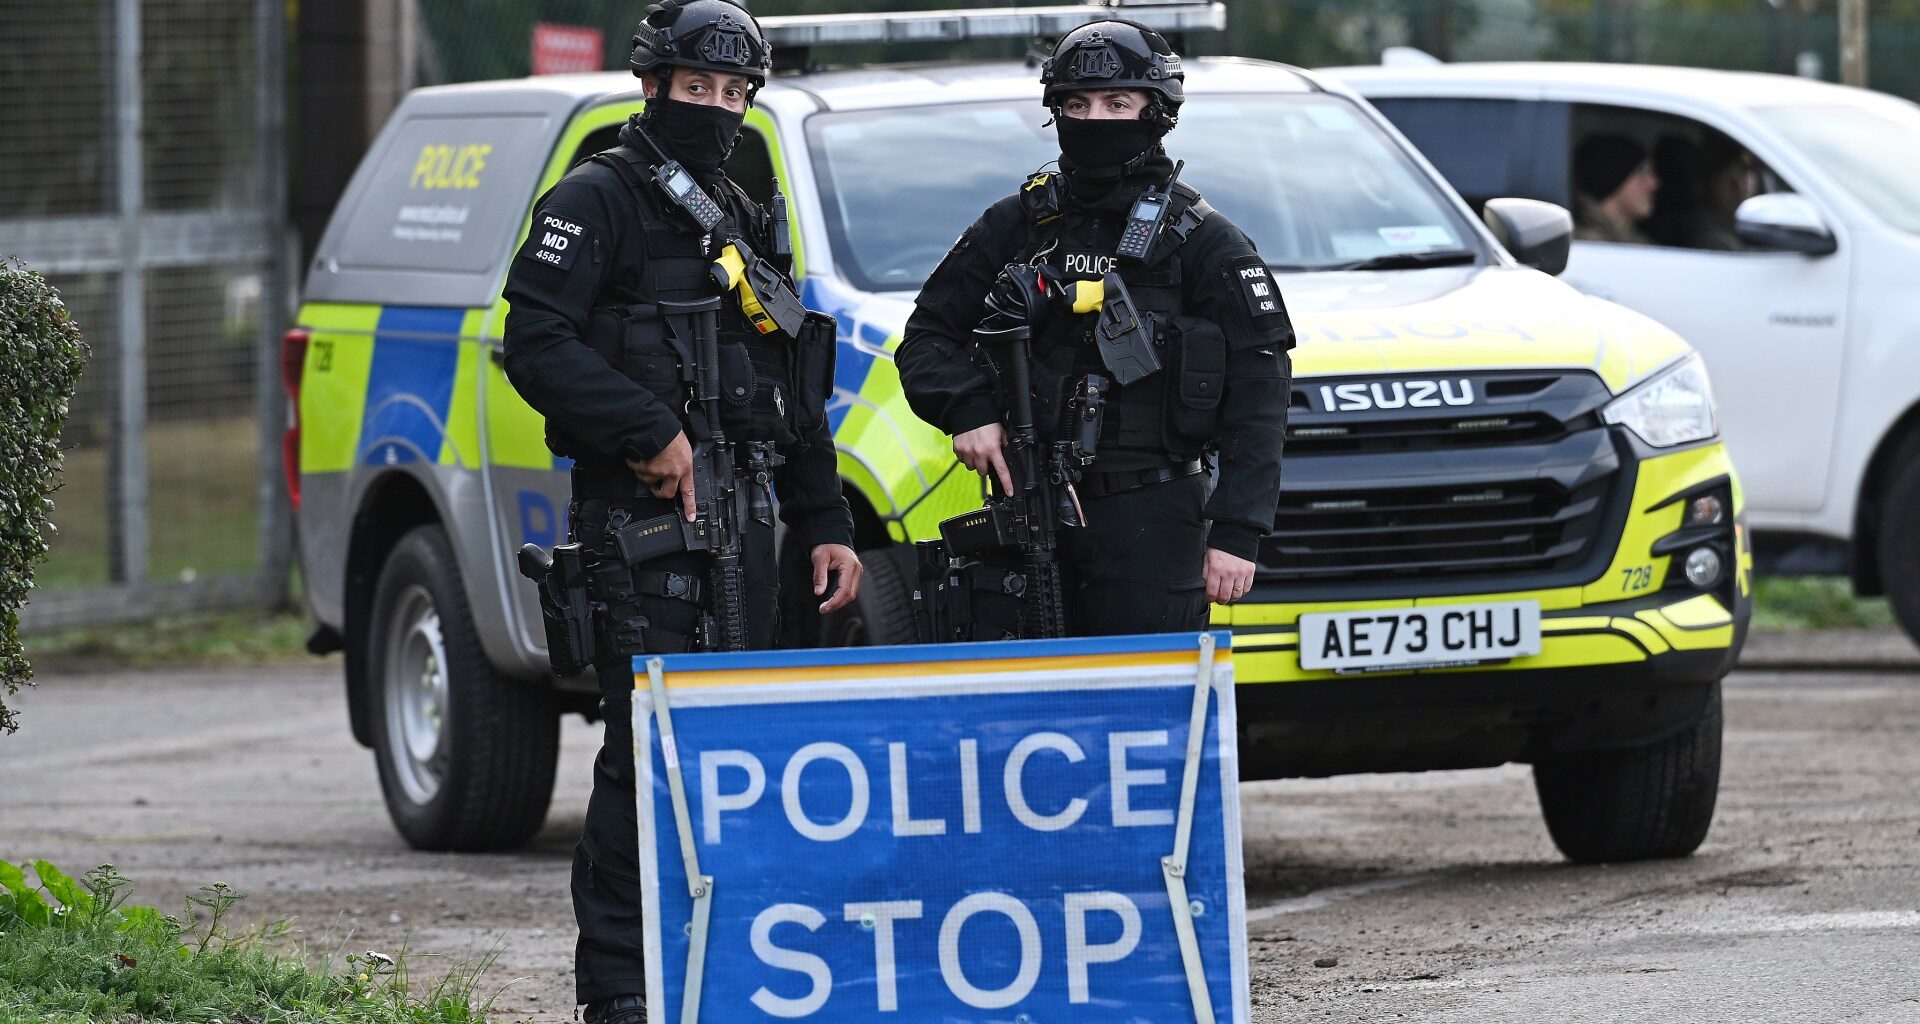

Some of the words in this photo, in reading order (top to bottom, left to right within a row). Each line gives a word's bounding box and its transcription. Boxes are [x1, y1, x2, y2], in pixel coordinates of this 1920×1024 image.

[409, 143, 493, 190] POLICE
[543, 216, 583, 236] POLICE
[541, 231, 569, 251] MD
[535, 249, 562, 265] 4582
[1065, 254, 1118, 275] POLICE
[1240, 267, 1266, 279] POLICE
[1251, 282, 1269, 297] MD
[1319, 378, 1475, 412] ISUZU
[1622, 564, 1653, 592] 728
[1321, 613, 1428, 660] AE73
[1441, 607, 1521, 651] CHJ
[700, 729, 1175, 845] POLICE
[749, 890, 1143, 1019] STOP
